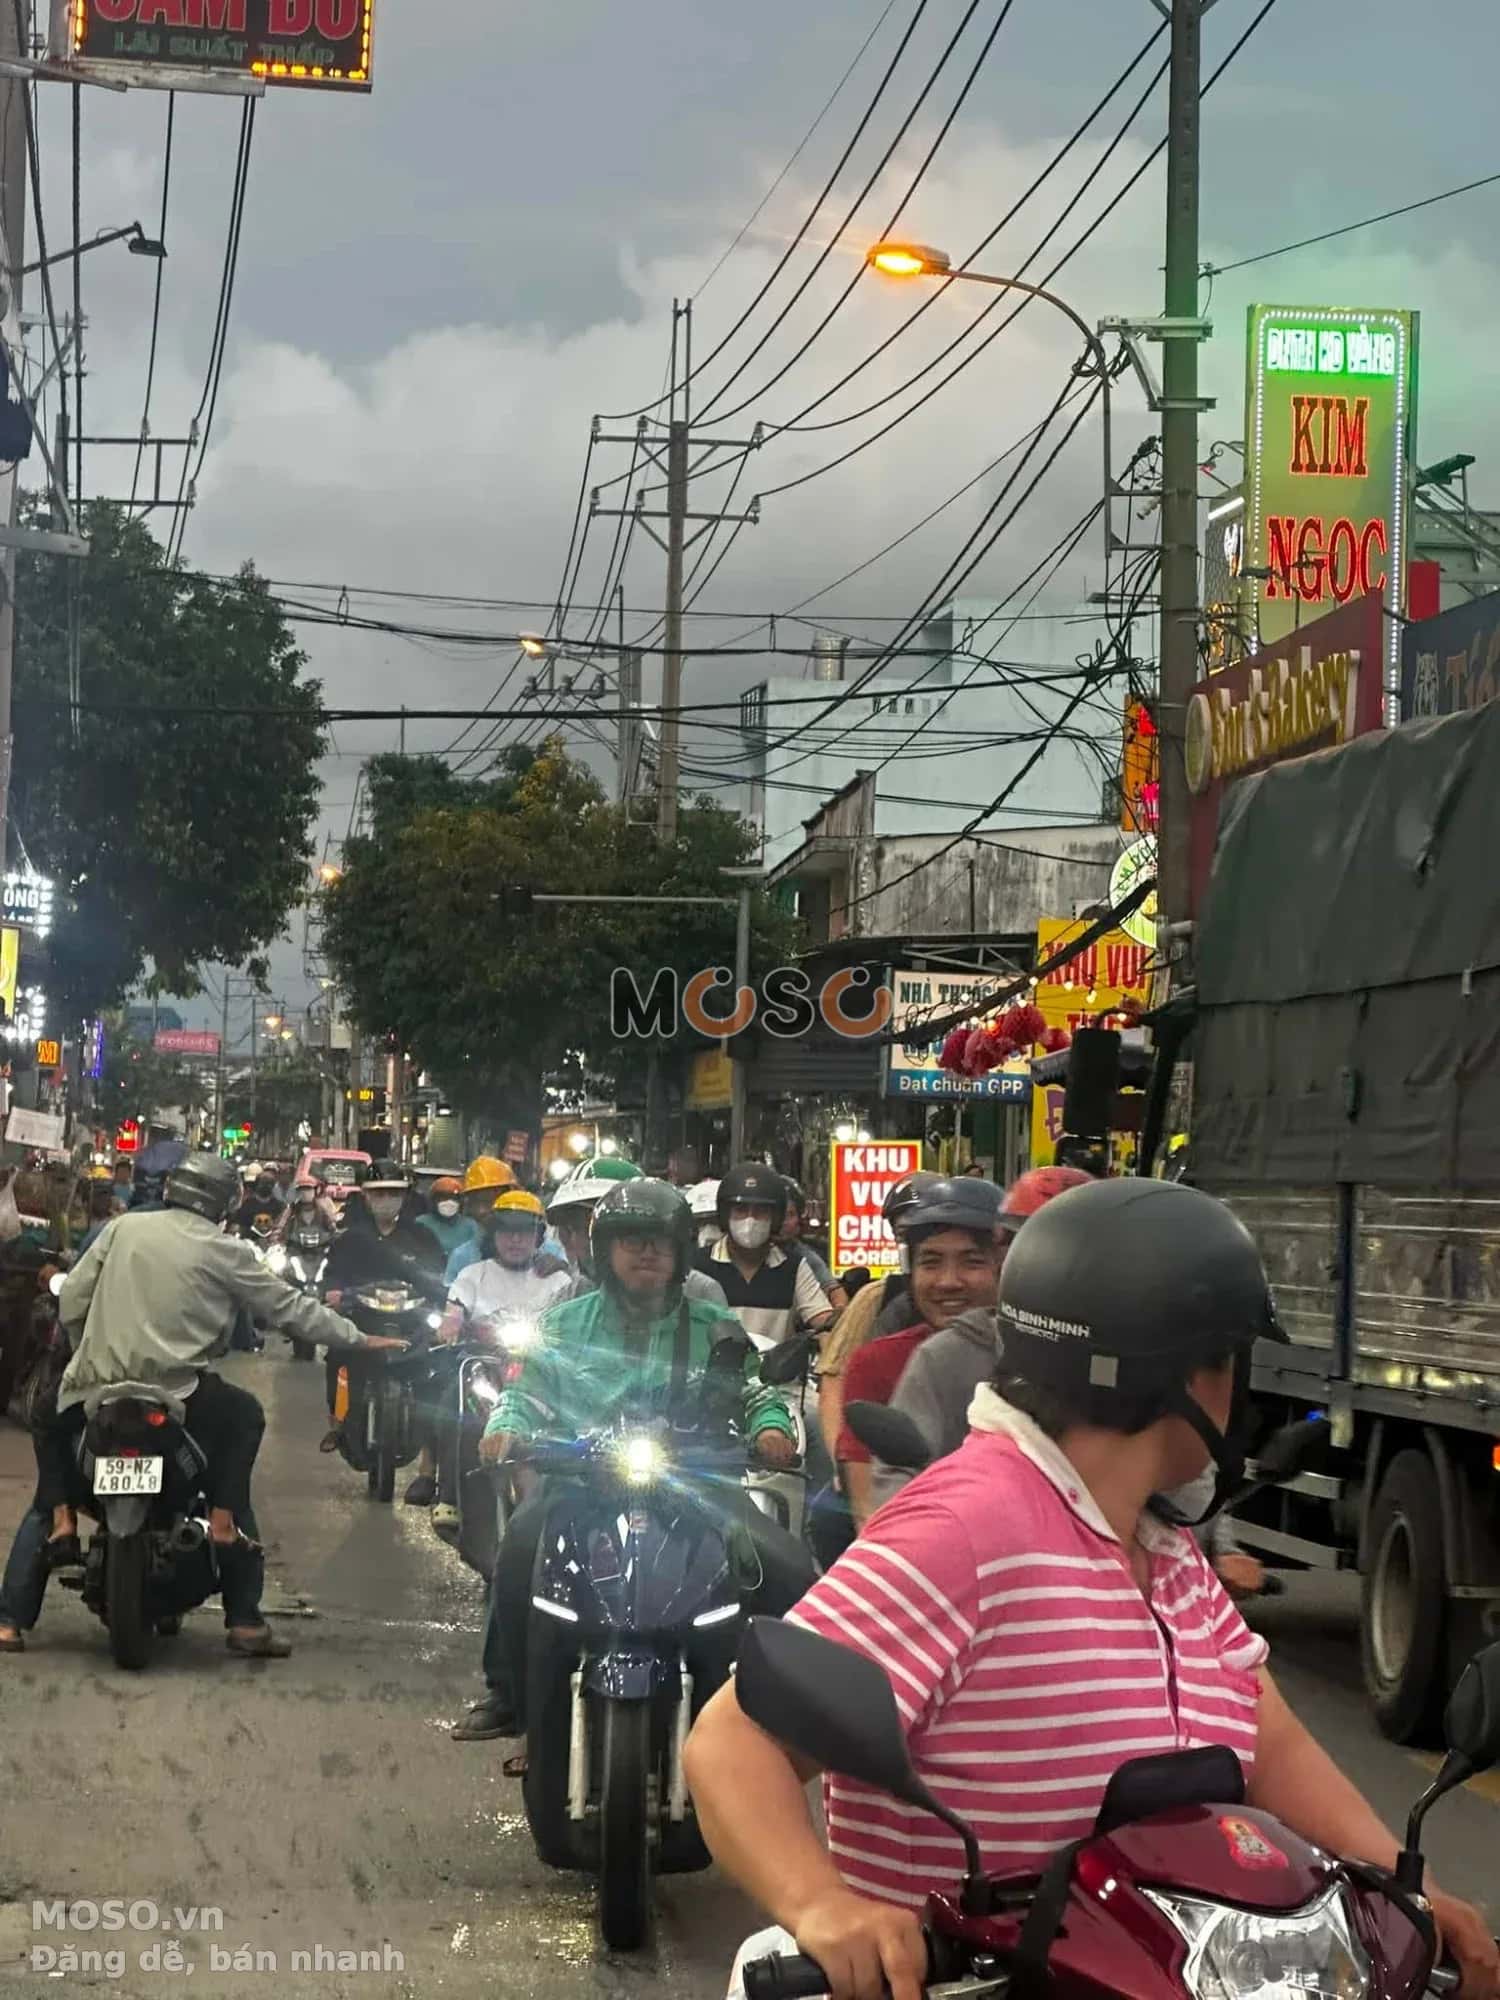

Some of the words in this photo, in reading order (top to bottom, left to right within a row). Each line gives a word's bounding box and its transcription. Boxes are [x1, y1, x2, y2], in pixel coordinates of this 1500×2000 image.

[1290, 395, 1369, 477] KIM
[1106, 944, 1147, 989] VUI
[900, 977, 932, 1004] NHÀ
[899, 1075, 928, 1094] Đạt
[988, 1078, 1024, 1095] GPP
[844, 1147, 910, 1172] KHU
[106, 1459, 153, 1475] 59-N2
[98, 1475, 157, 1491] 480.48
